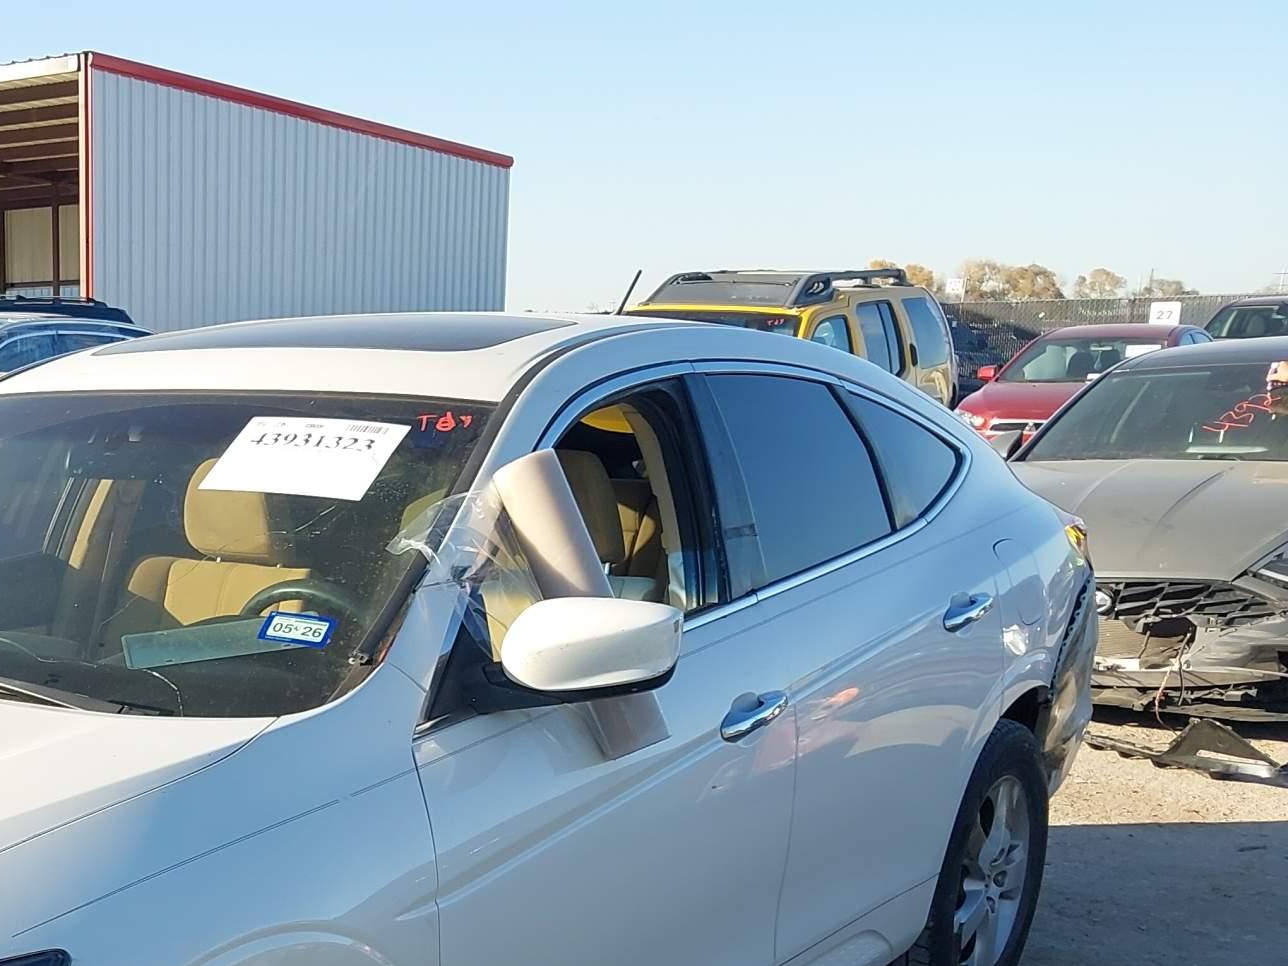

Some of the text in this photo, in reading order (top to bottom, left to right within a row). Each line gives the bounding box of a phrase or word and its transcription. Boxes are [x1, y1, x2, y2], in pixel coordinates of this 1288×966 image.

[1155, 310, 1173, 320] 27
[250, 432, 376, 452] 43931323
[272, 622, 324, 638] 05 26
